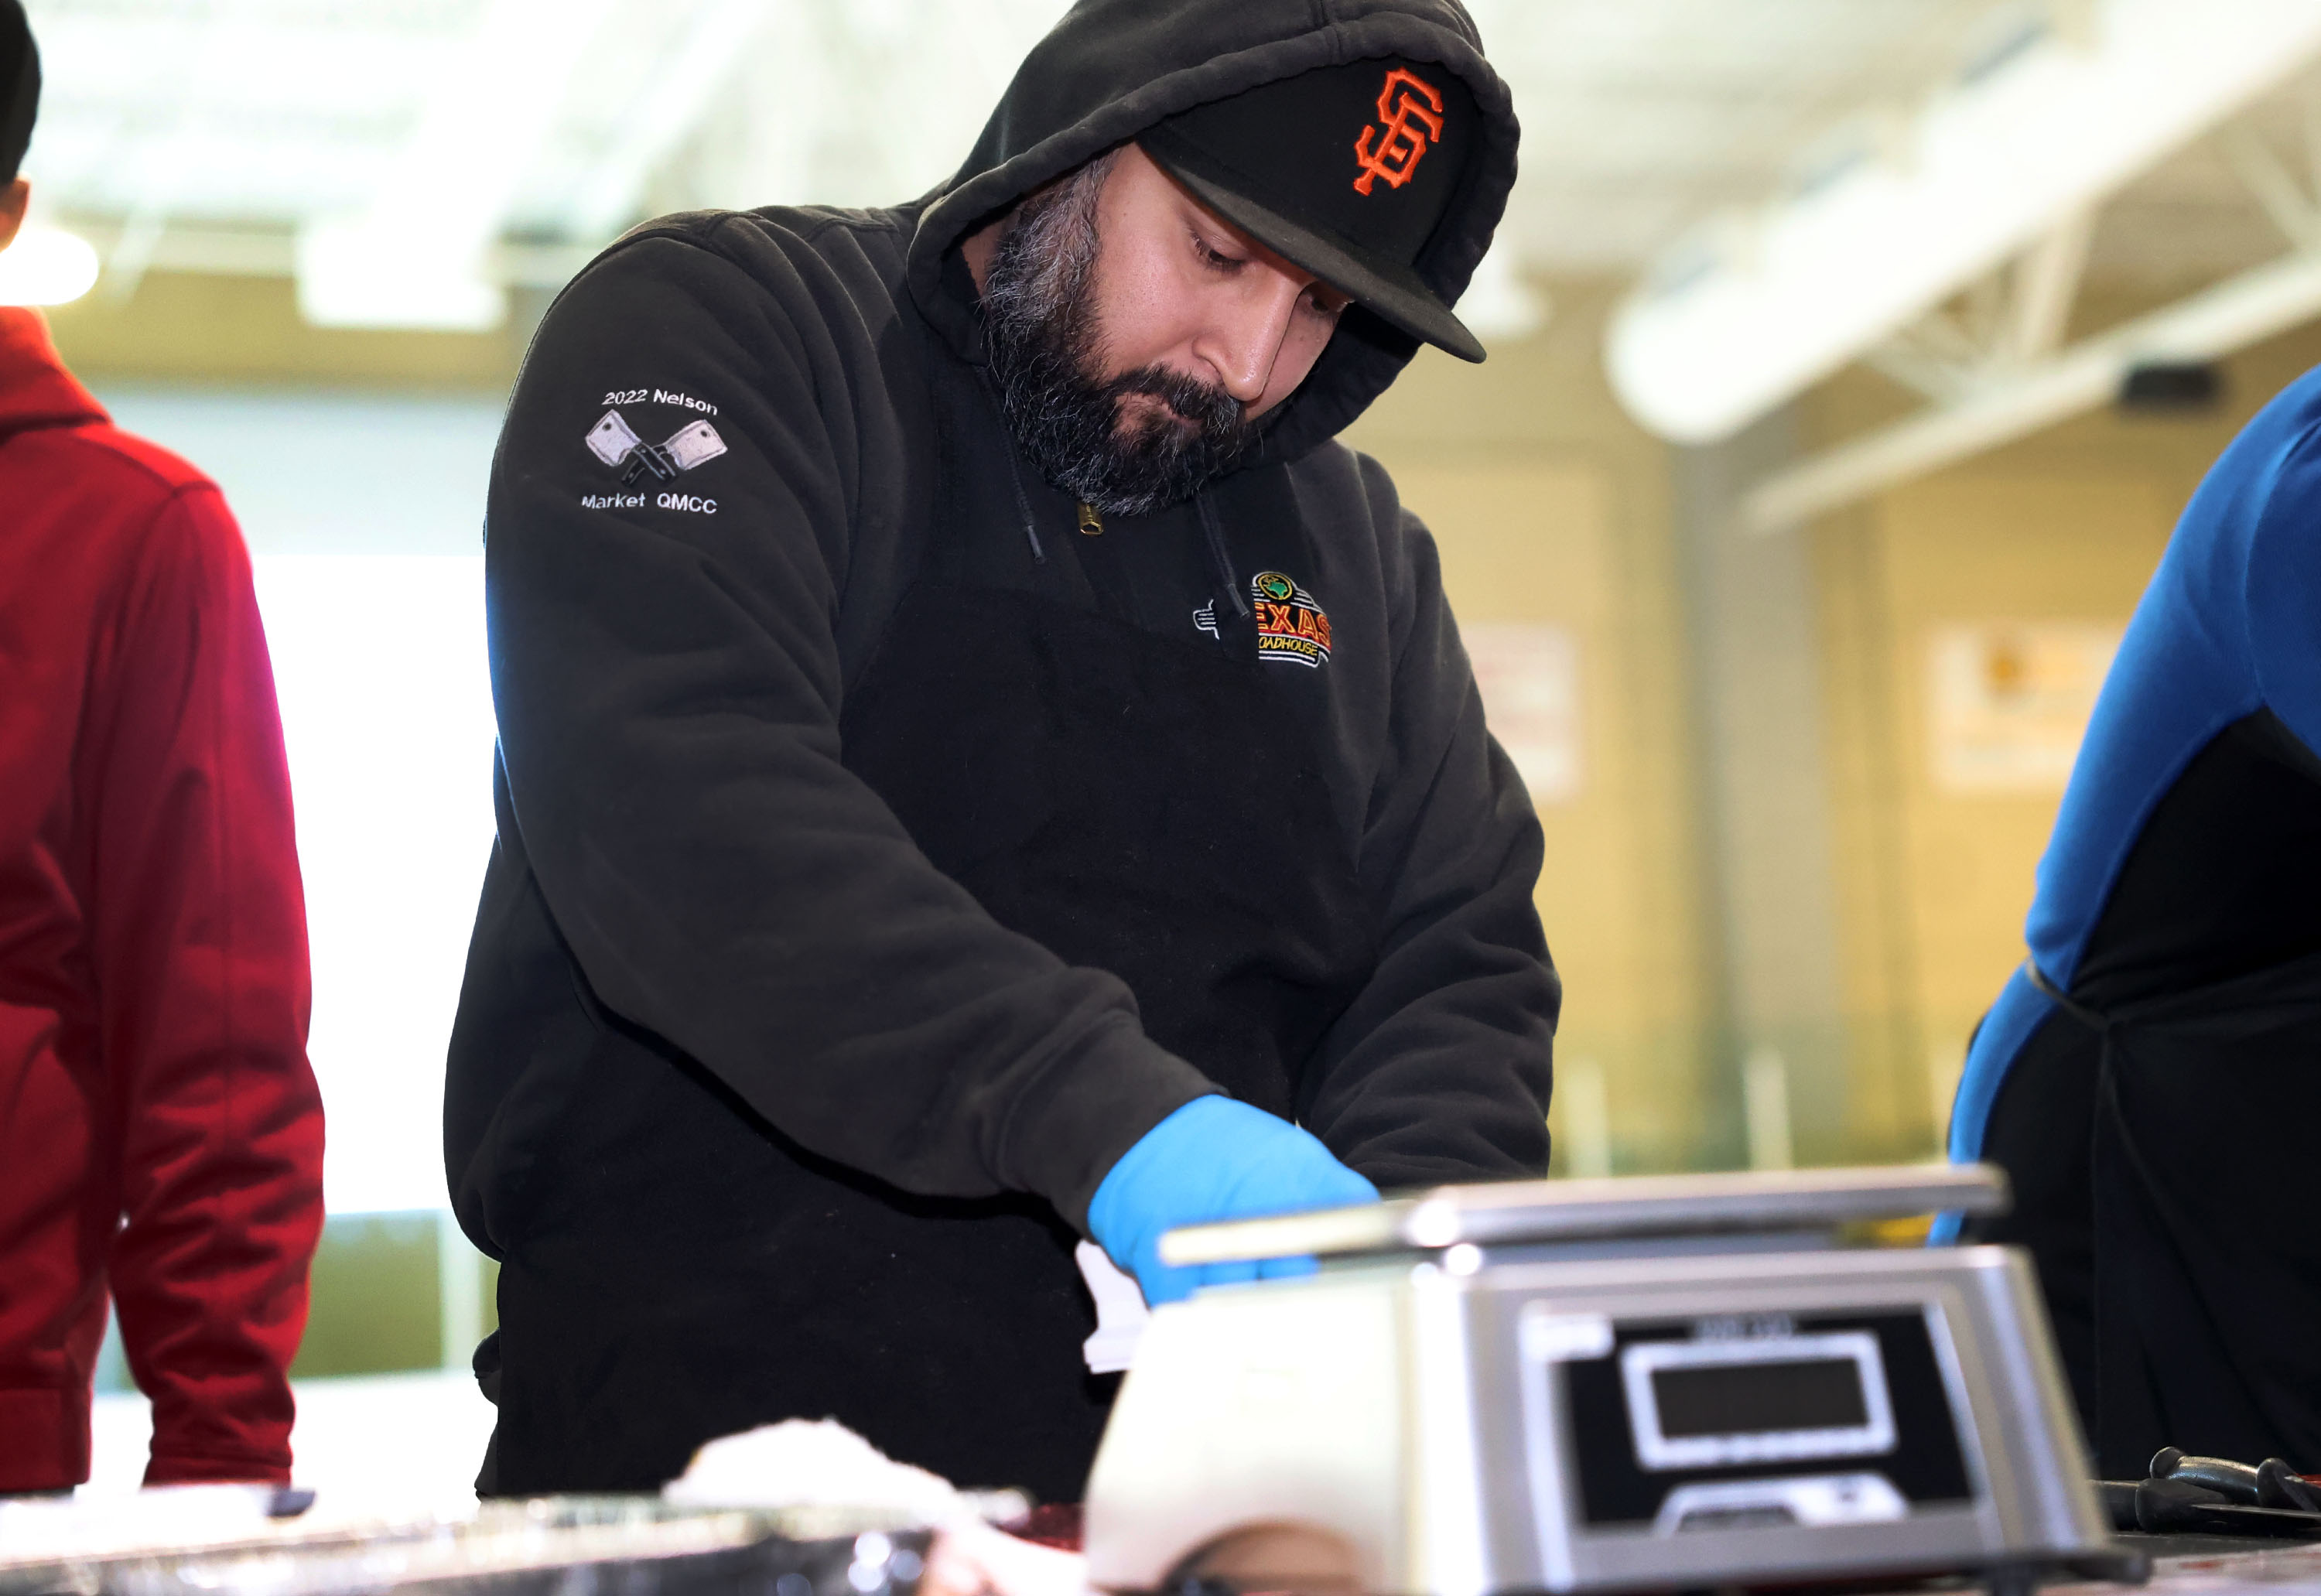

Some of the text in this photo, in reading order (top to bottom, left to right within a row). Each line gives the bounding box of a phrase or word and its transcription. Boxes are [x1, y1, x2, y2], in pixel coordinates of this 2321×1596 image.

[601, 389, 718, 415] 2022 Nelson
[582, 493, 717, 514] Market QMCC
[1254, 602, 1331, 650] EXAS
[1258, 636, 1318, 656] OADHOUSE
